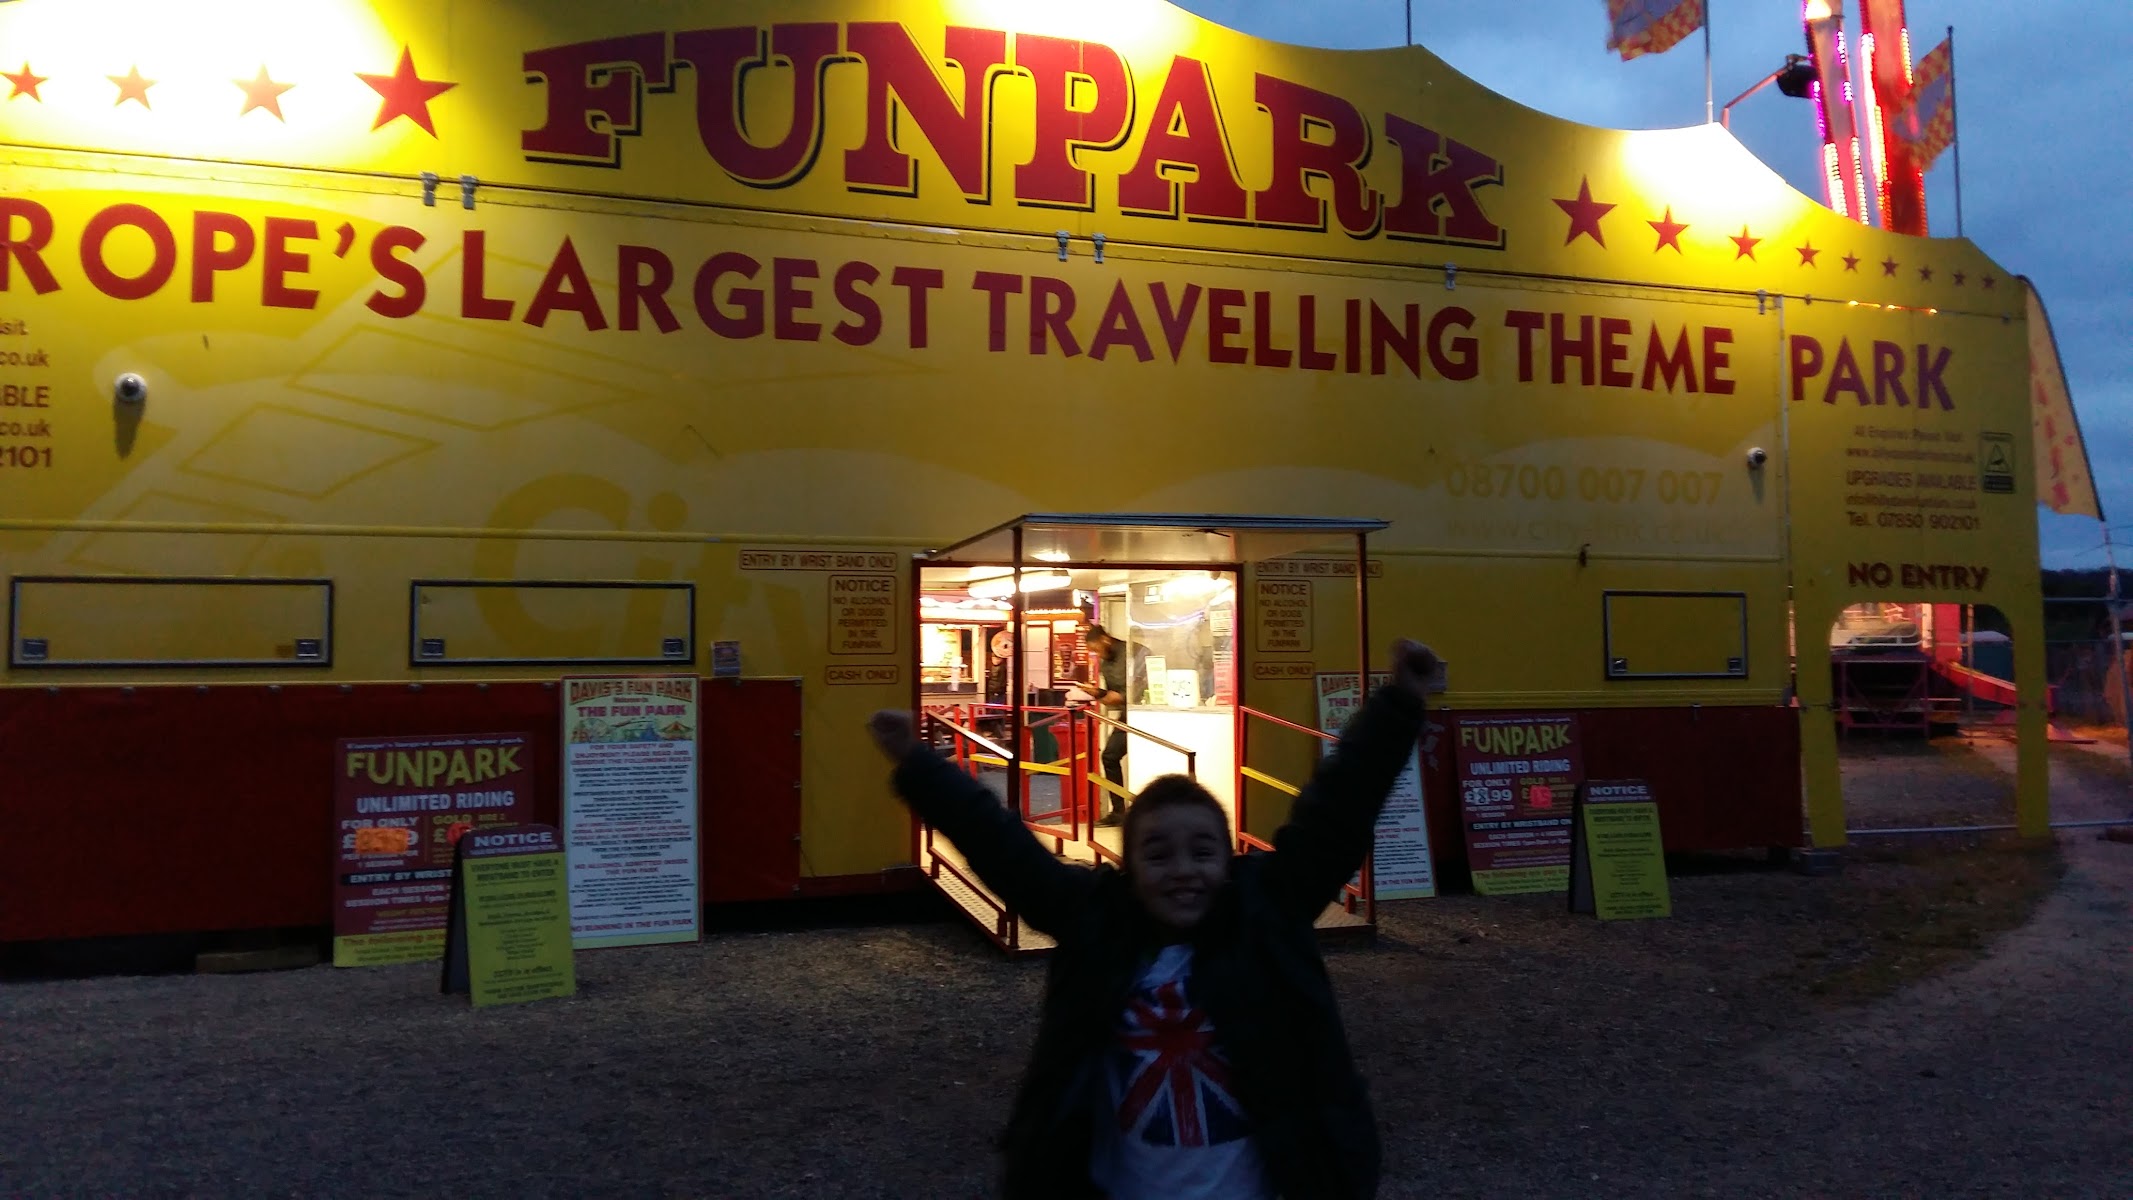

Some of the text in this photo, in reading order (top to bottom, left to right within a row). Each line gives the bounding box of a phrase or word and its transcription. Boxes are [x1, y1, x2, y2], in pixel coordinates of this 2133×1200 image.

[523, 22, 1507, 250] FUNPARK
[461, 229, 943, 349] LARGEST
[973, 270, 1478, 381] TRAVELLING
[1505, 310, 1735, 395] THEME
[1790, 334, 1955, 411] PARK
[1446, 463, 1725, 506] 08700 007 007
[1846, 470, 1913, 487] UPGRADES
[1916, 473, 1978, 491] AVAILABLE
[1877, 512, 1924, 529] 07850
[742, 553, 894, 568] ENTRY BY WRIST BAND ONLY
[1848, 562, 1990, 592] NO ENTRY
[834, 579, 891, 592] NOTICE
[1260, 583, 1307, 596] NOTICE
[833, 596, 893, 605] NO ALCOHOL
[841, 608, 885, 617] OR DOGS
[838, 619, 888, 628] PERMITTED
[859, 630, 877, 639] THE
[828, 669, 894, 680] CASH ONLY
[1256, 665, 1311, 675] CASH ONLY
[627, 681, 653, 695] FUN
[655, 681, 692, 703] PARK
[577, 704, 685, 717] THE FUN PARK
[1460, 724, 1573, 757] FUNPARK
[346, 745, 523, 788] FUNPARK
[1470, 759, 1571, 775] UNLIMITED RIDING
[1462, 778, 1512, 788] FOR ONLY
[1590, 785, 1647, 795] NOTICE
[356, 790, 516, 813] UNLIMITED RIDING
[341, 816, 420, 830] FOR ONLY
[432, 813, 473, 826] GOLD
[474, 832, 553, 847] NOTICE
[350, 872, 391, 884] ENTRY
[394, 871, 411, 880] BY
